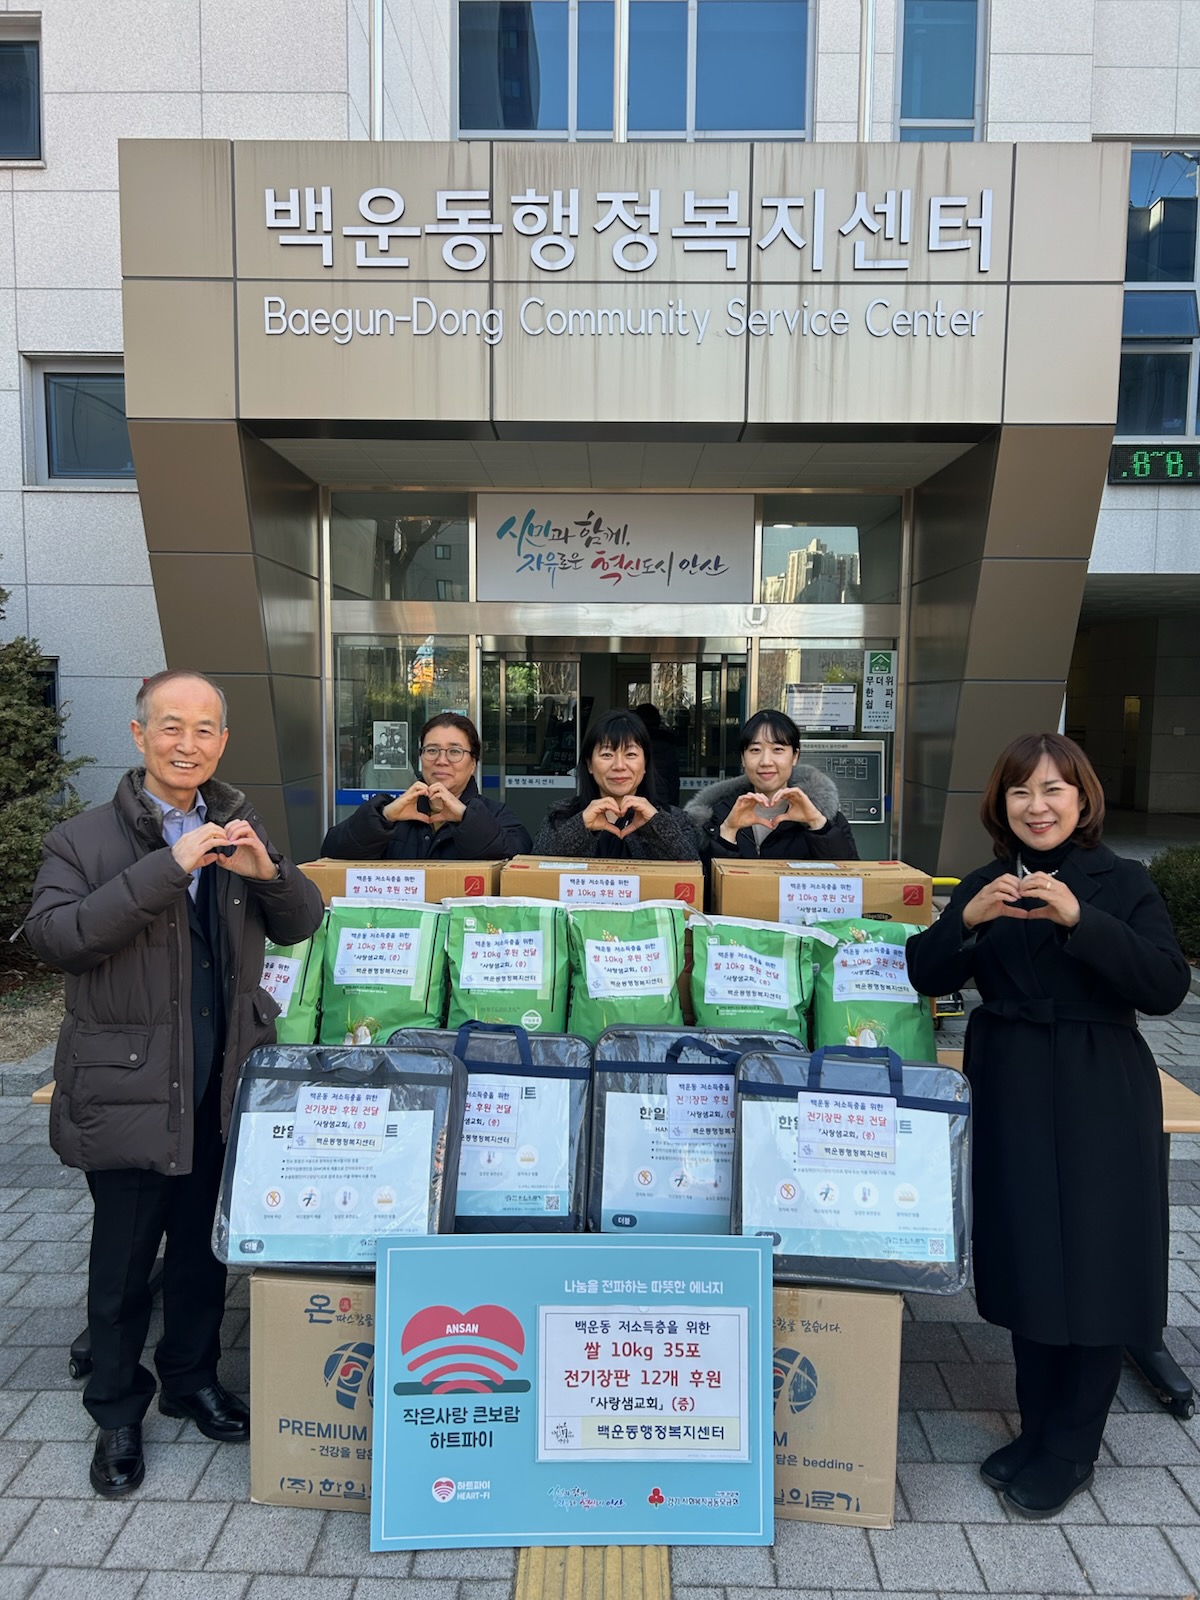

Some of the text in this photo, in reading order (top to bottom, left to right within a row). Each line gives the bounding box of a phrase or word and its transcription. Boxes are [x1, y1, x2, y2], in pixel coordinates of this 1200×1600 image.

[265, 186, 993, 273] 백운동행정복지센터
[263, 296, 984, 346] Baegun-Dong Community Service Center
[496, 508, 576, 556] 시민과
[516, 550, 730, 589] 자유로운 혁신도시 안산
[866, 676, 894, 686] 무더위
[570, 878, 585, 886] 백운동
[353, 886, 418, 895] 쌀 10kg 후원 전달
[566, 889, 632, 898] 쌀 10kg 후원 전달
[787, 893, 855, 903] 쌀 10kg 후원 전달
[357, 943, 376, 951] 10kg
[604, 955, 623, 964] 10kg
[726, 962, 745, 971] 10kg
[275, 973, 290, 984] 전달
[679, 1083, 697, 1091] 백운동
[310, 1092, 328, 1100] 백운동
[365, 1093, 378, 1102] 위한
[497, 1092, 510, 1100] 위한
[676, 1095, 729, 1105] 전기장판 후원
[304, 1104, 379, 1116] 전기장판 후원 전달
[476, 1103, 491, 1113] 후원
[495, 1104, 512, 1114] 전달
[810, 1099, 830, 1108] 백운동
[870, 1103, 884, 1112] 위한
[640, 1106, 666, 1121] 한일
[807, 1111, 887, 1127] 전기장판 후원 전달
[488, 1118, 500, 1127] (증)
[316, 1137, 375, 1147] 백운동행정복지센터
[824, 1147, 888, 1158] 백운동행정복지센터
[564, 1279, 724, 1295] 나눔을 전파하는 따뜻한 에너지
[304, 1294, 336, 1324] 온
[446, 1323, 479, 1334] ANSAN
[575, 1320, 711, 1335] 백운동 저소득층을 위한
[800, 1319, 842, 1334] 담습니다.
[584, 1341, 701, 1361] 쌀 10kg 35포
[564, 1369, 722, 1389] 전기장판 12개 후원
[671, 1396, 695, 1411] (증)
[403, 1405, 520, 1425] 작은사랑 큰보람
[278, 1418, 367, 1441] PREMIUM
[597, 1424, 725, 1440] 백운동행정복지센터
[429, 1430, 493, 1449] 하트파이
[319, 1445, 351, 1458] 건강을
[775, 1453, 853, 1471] 담은 bedding
[280, 1476, 372, 1500] (주) 한일
[457, 1480, 490, 1490] 하트파이
[457, 1491, 490, 1500] HEART-FI
